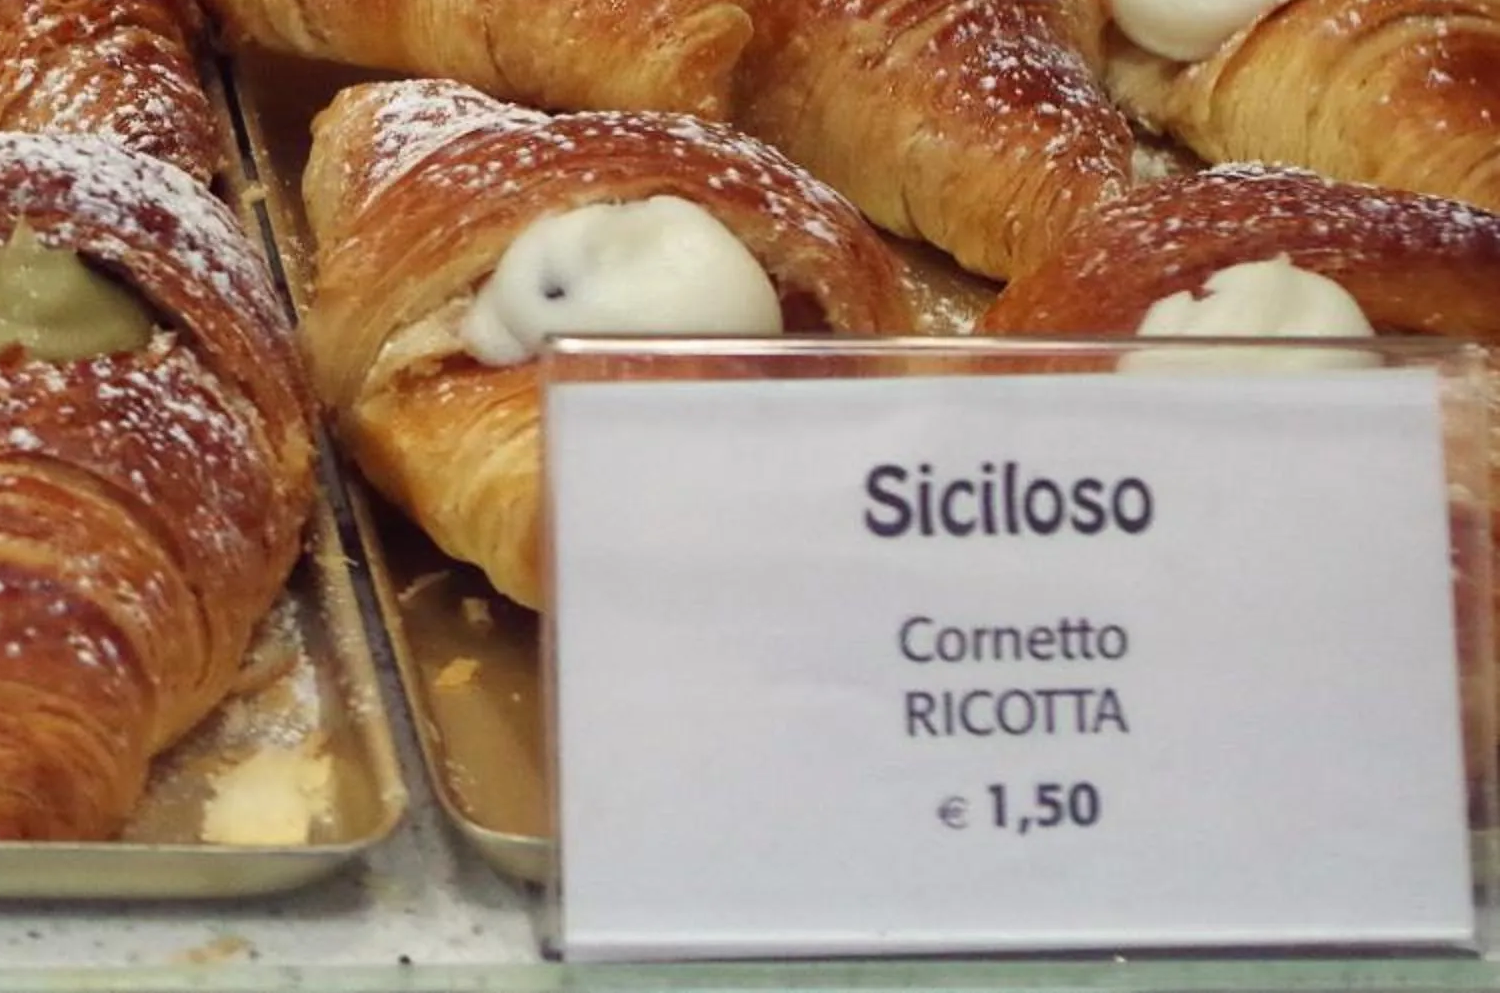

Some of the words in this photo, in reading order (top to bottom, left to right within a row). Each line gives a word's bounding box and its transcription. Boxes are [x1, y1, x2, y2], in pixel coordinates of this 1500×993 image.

[864, 461, 1155, 538] Siciloso
[898, 615, 1129, 664] Cornetto
[905, 688, 1130, 737] RICOTTA
[937, 799, 968, 830] €
[987, 782, 1101, 835] 1,50
